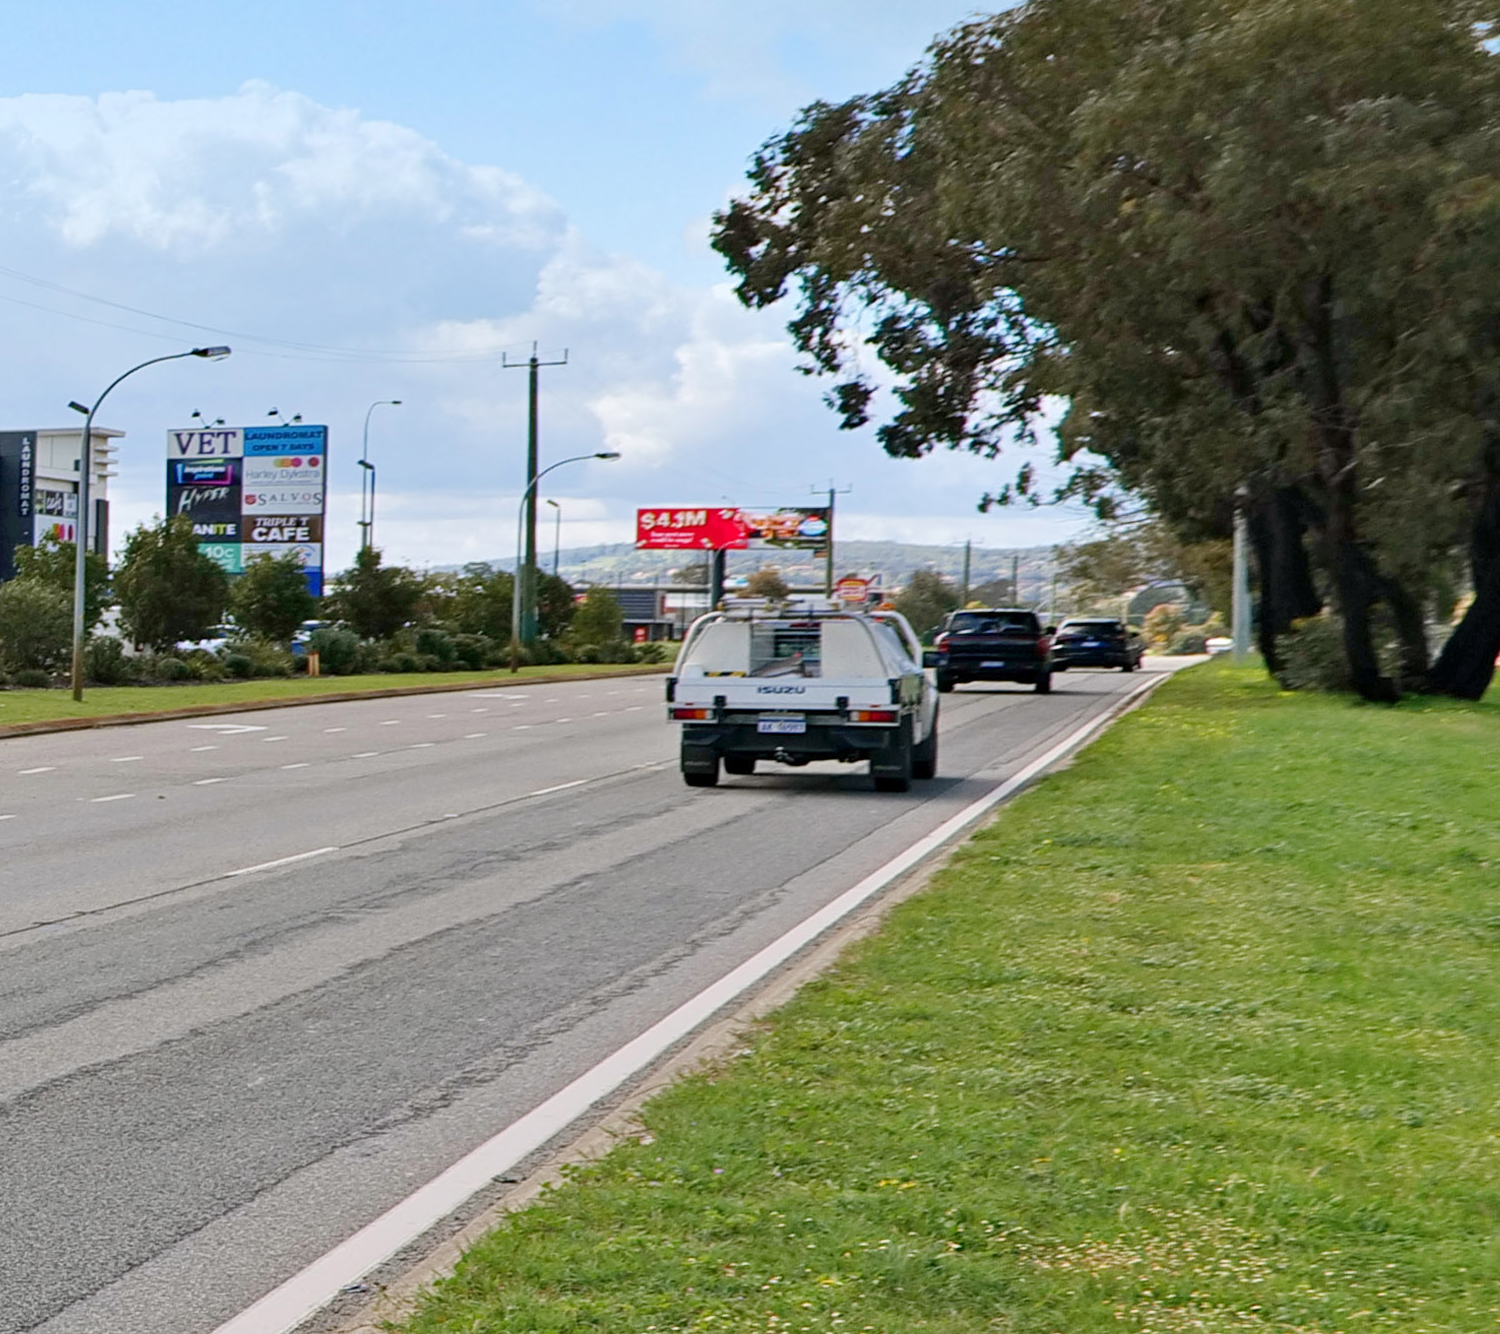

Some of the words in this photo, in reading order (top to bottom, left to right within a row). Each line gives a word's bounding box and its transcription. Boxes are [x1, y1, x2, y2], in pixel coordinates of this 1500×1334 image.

[245, 431, 323, 441] LAUNDROMAT
[175, 431, 236, 455] VET
[252, 444, 278, 452] OPEN
[289, 443, 315, 451] DAYS
[21, 437, 31, 516] LAUNDROMAT
[246, 469, 278, 480] Harley
[177, 487, 230, 516] HYPER
[258, 492, 323, 507] SALVOS
[255, 517, 293, 527] TRIPLE
[301, 517, 310, 527] T
[192, 523, 237, 535] ANITE
[252, 527, 310, 542] CAFE
[757, 686, 806, 695] ISUZU
